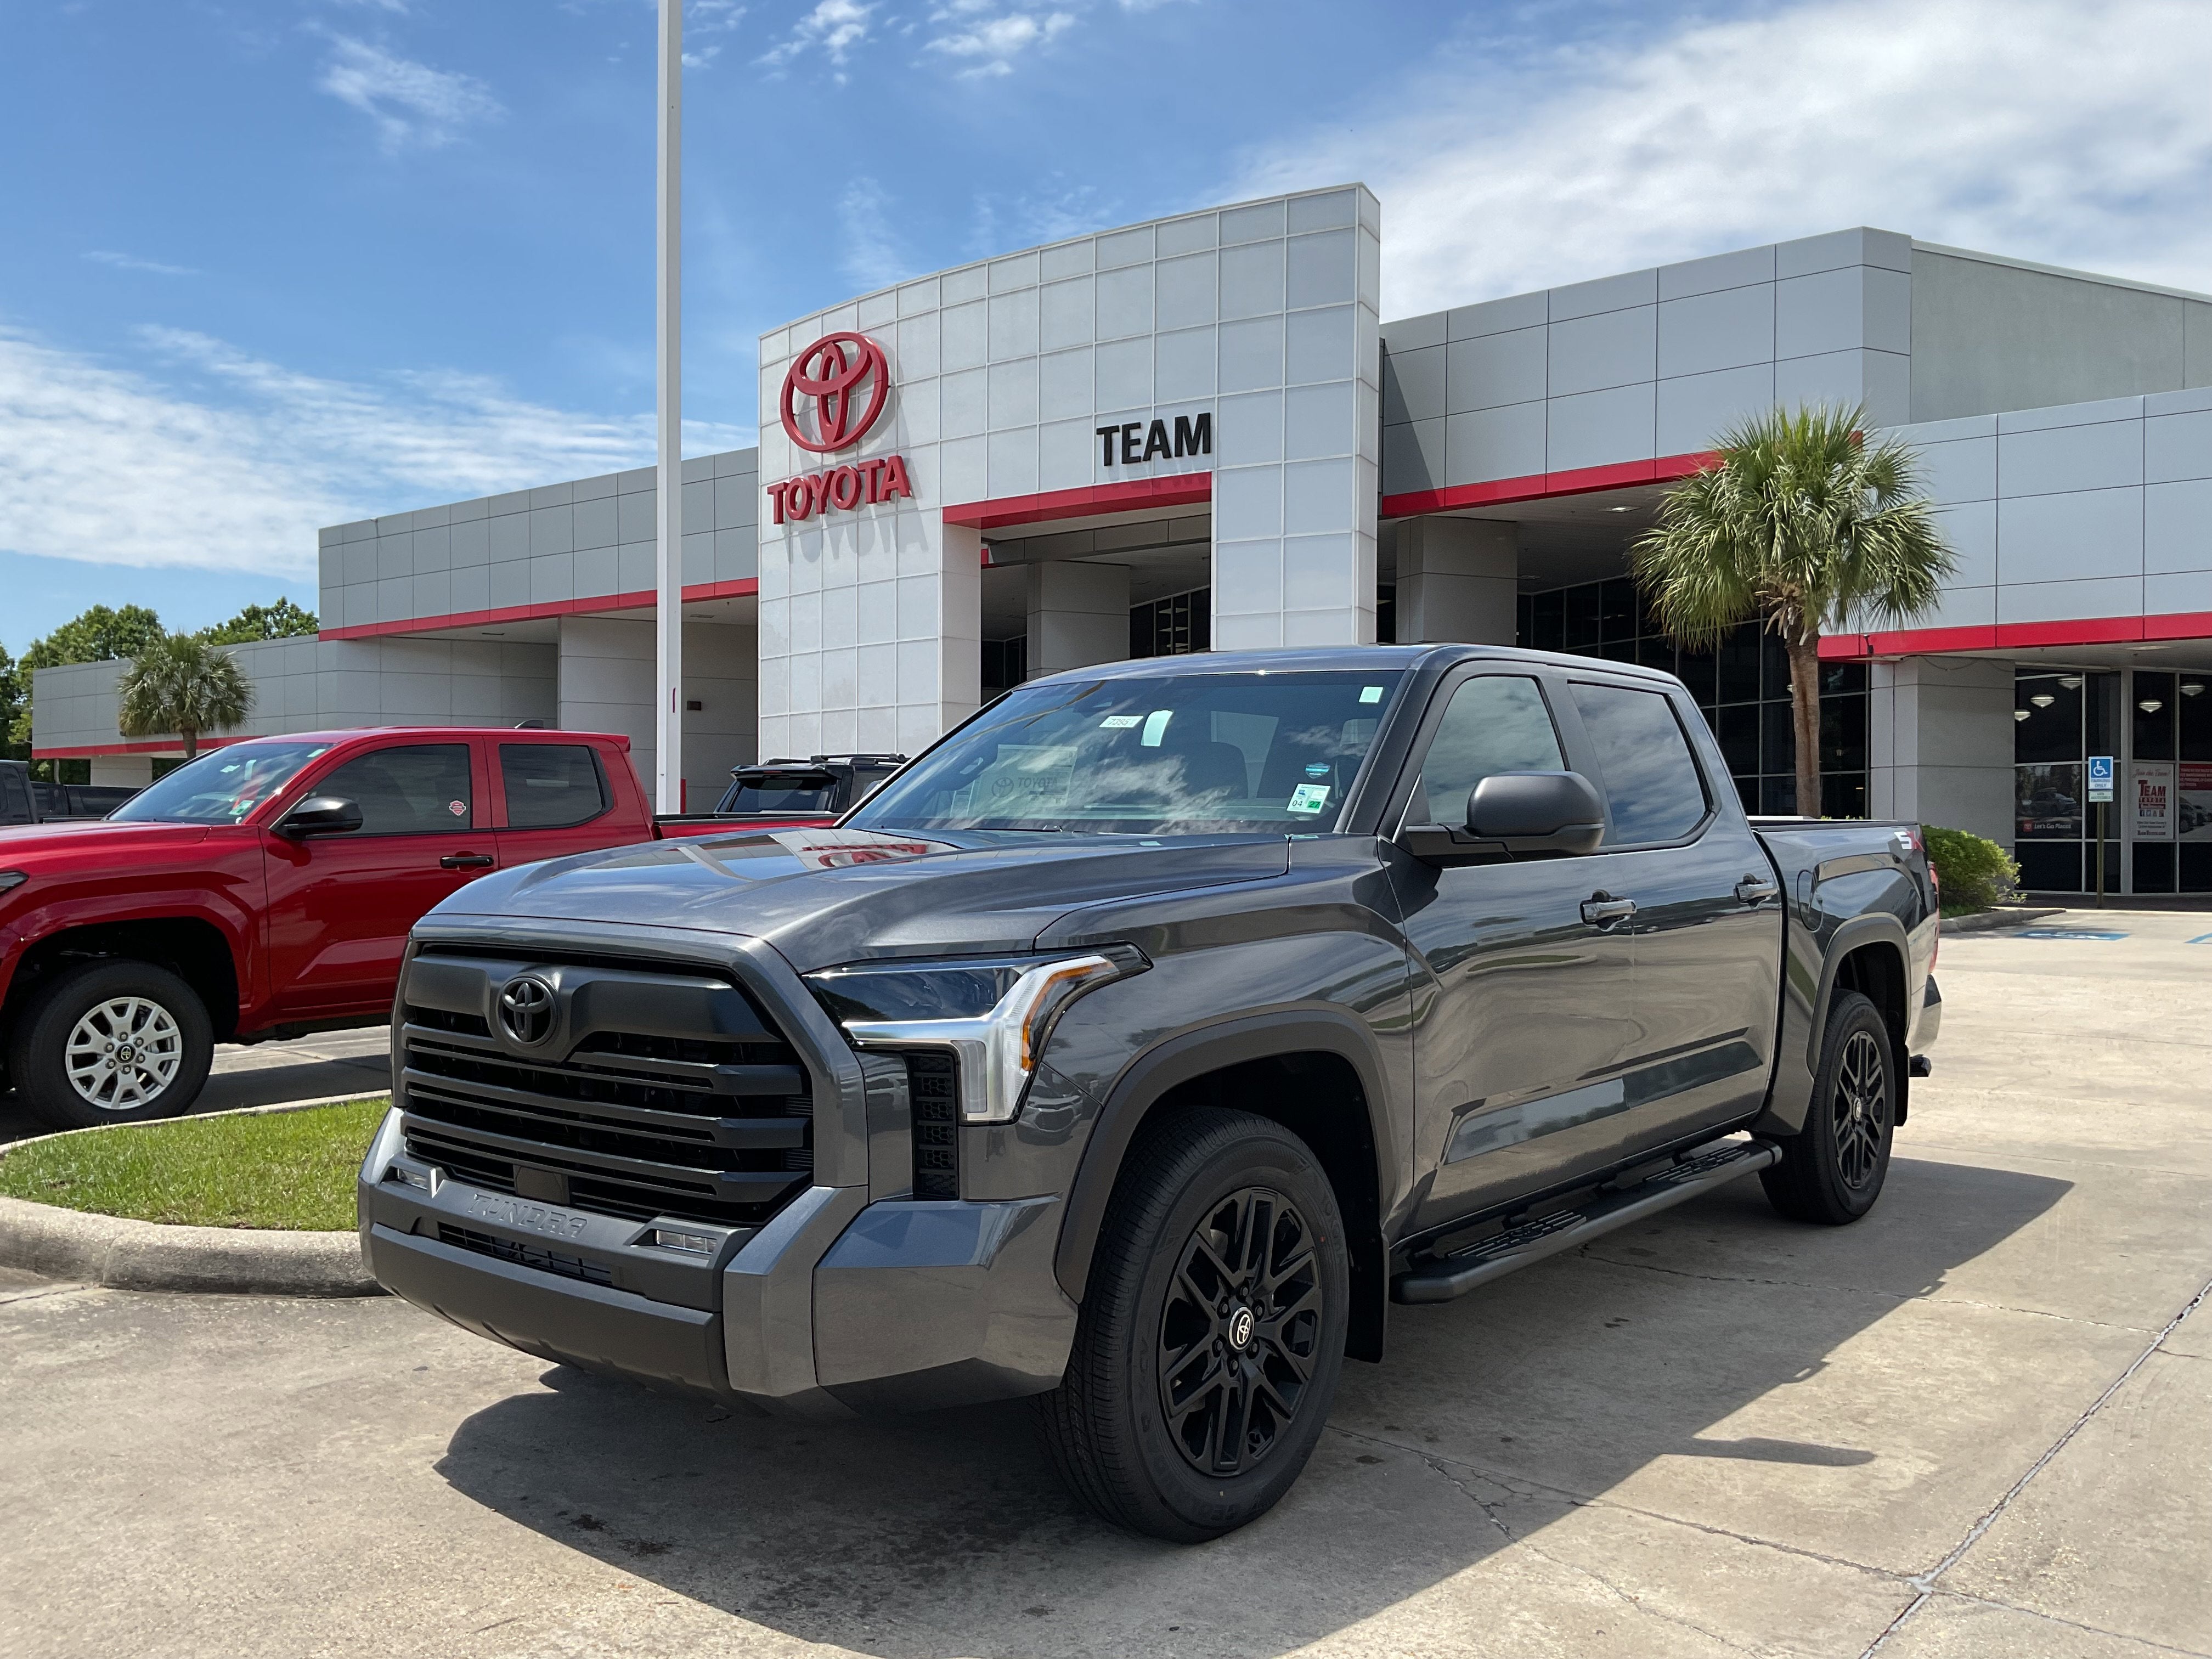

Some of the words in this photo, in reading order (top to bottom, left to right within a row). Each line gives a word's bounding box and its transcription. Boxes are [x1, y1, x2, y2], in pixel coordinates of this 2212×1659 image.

[1096, 412, 1211, 466] TEAM
[767, 455, 912, 525] TOYOTA
[2138, 780, 2166, 797] TEAM
[467, 1193, 588, 1238] TUNDRA
